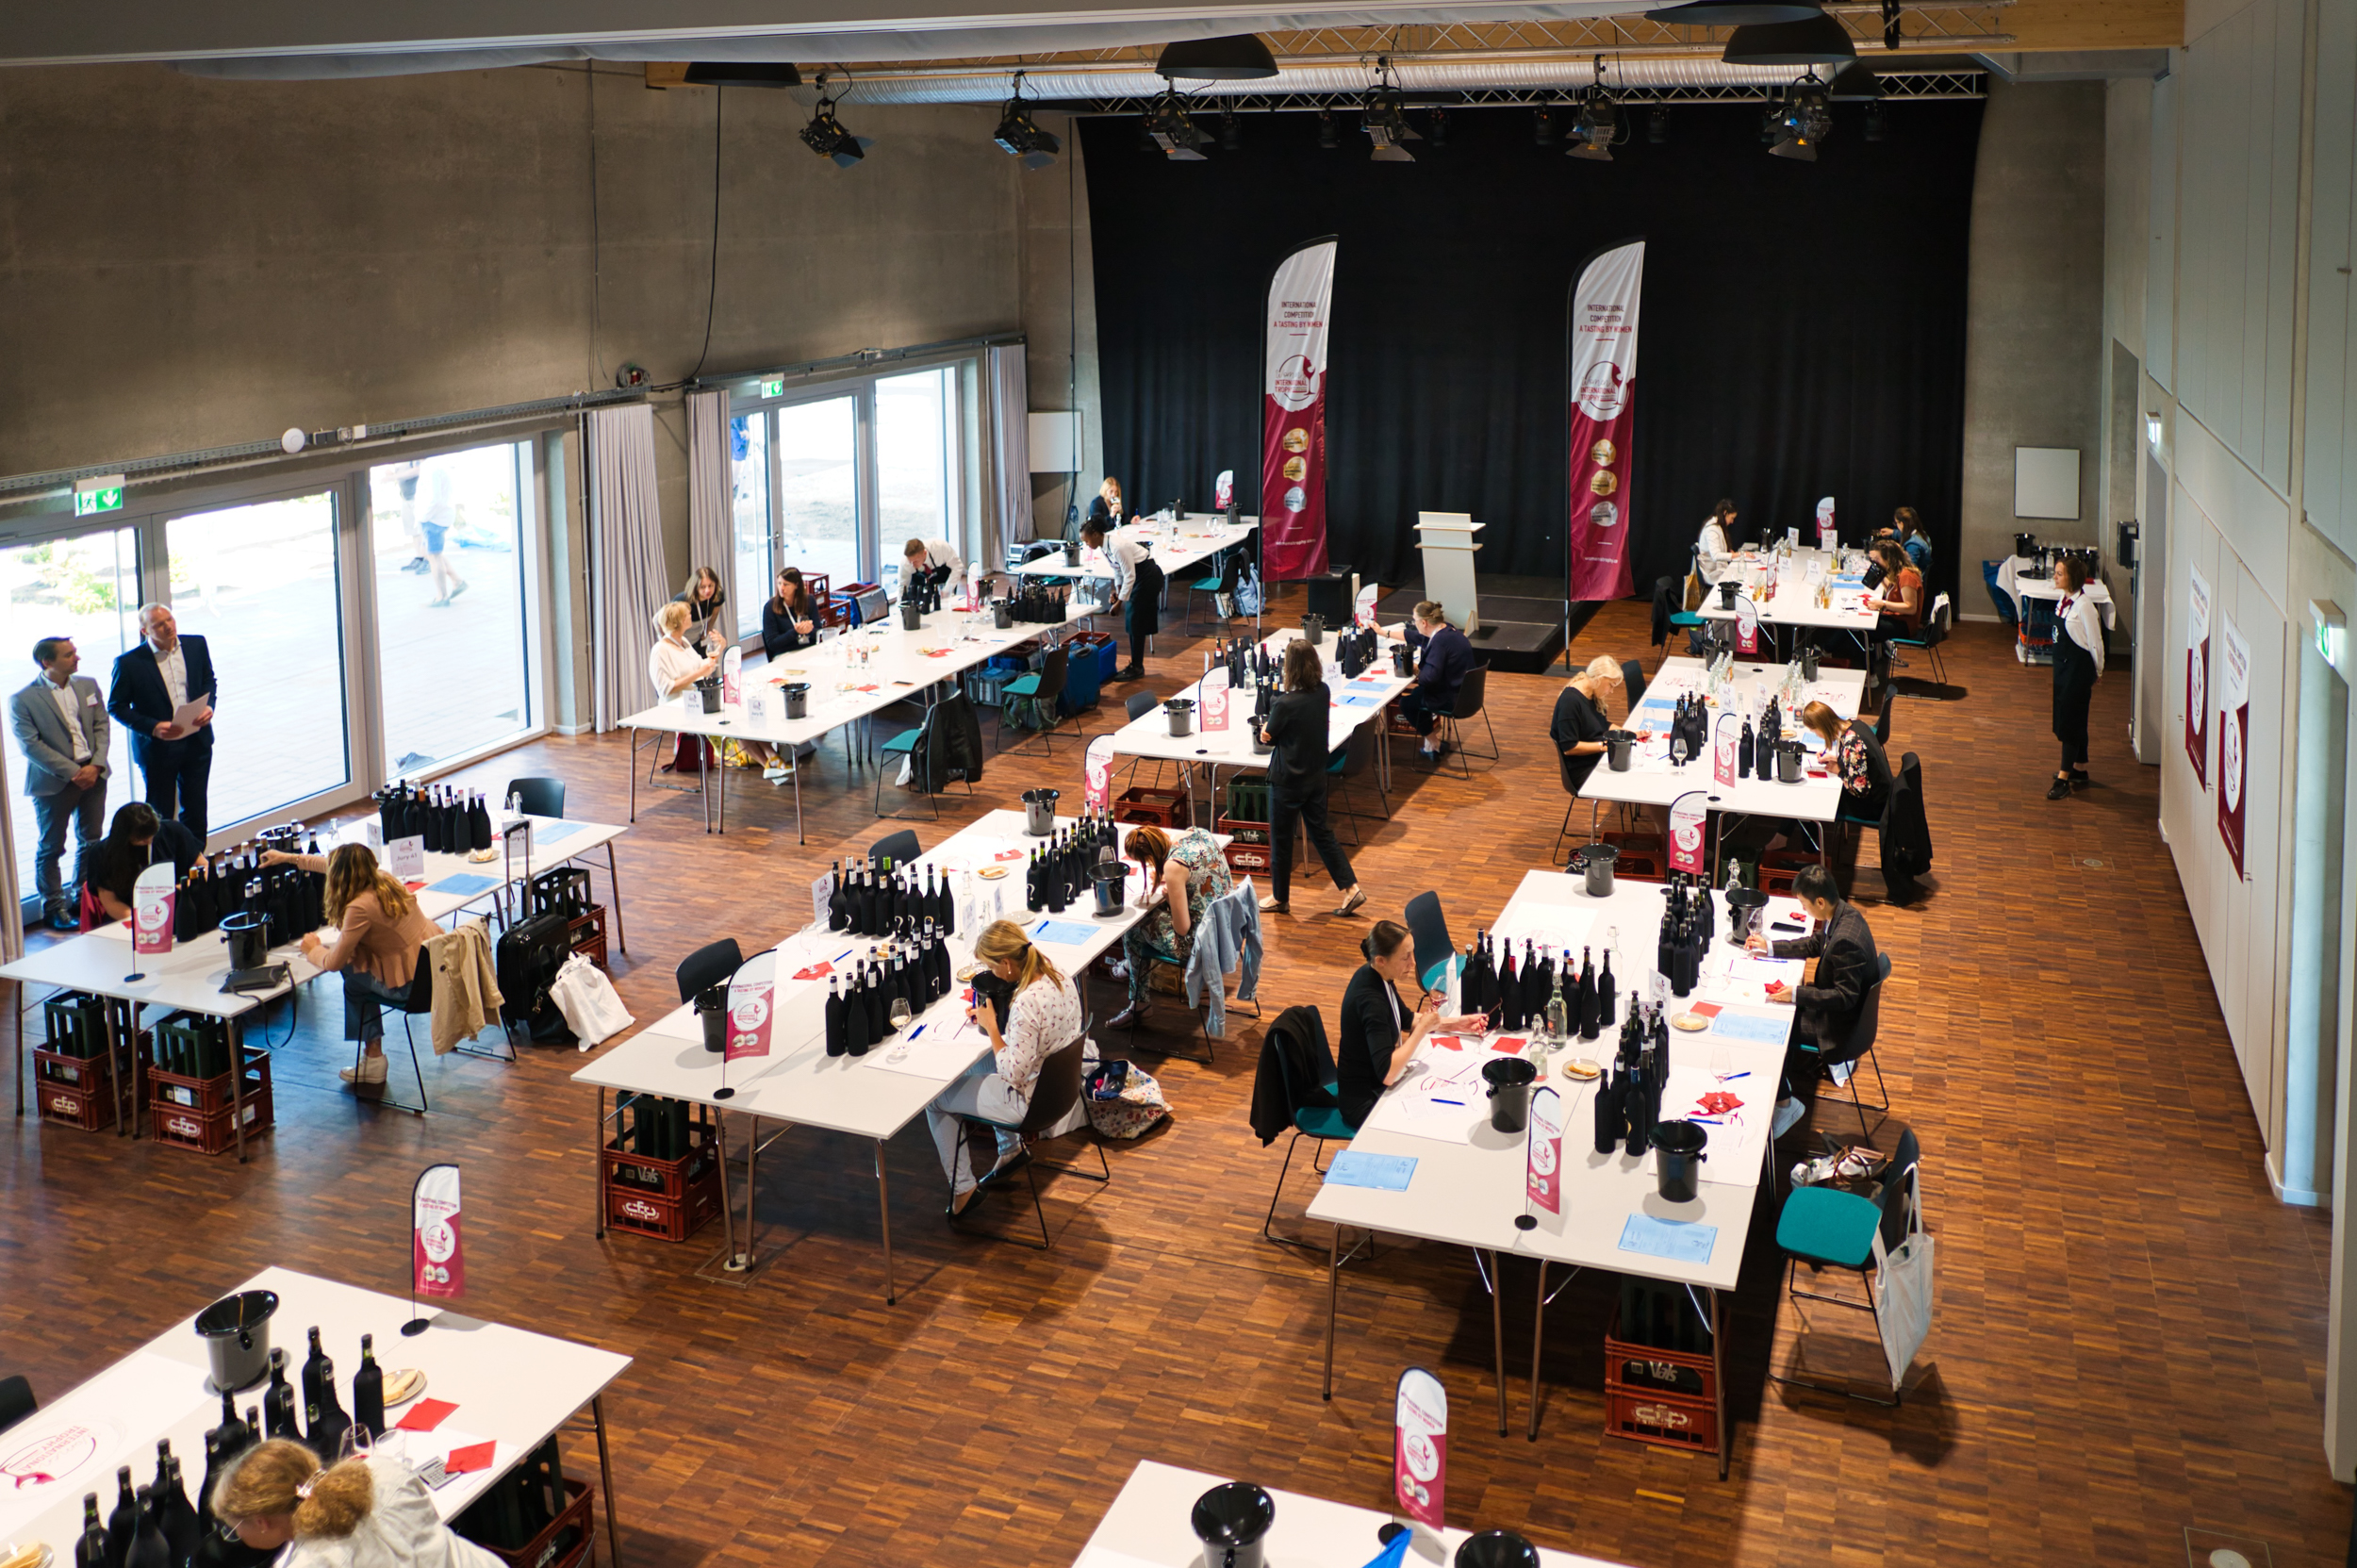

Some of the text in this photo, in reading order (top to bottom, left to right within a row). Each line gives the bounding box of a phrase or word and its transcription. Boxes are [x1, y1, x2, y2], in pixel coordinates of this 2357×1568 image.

[1587, 304, 1624, 312] INTERNATIONAL
[624, 1200, 657, 1220] cfp
[1648, 1360, 1678, 1382] Vals
[41, 1426, 82, 1451] TROPHY
[18, 1428, 90, 1473] INTERNATIONAL
